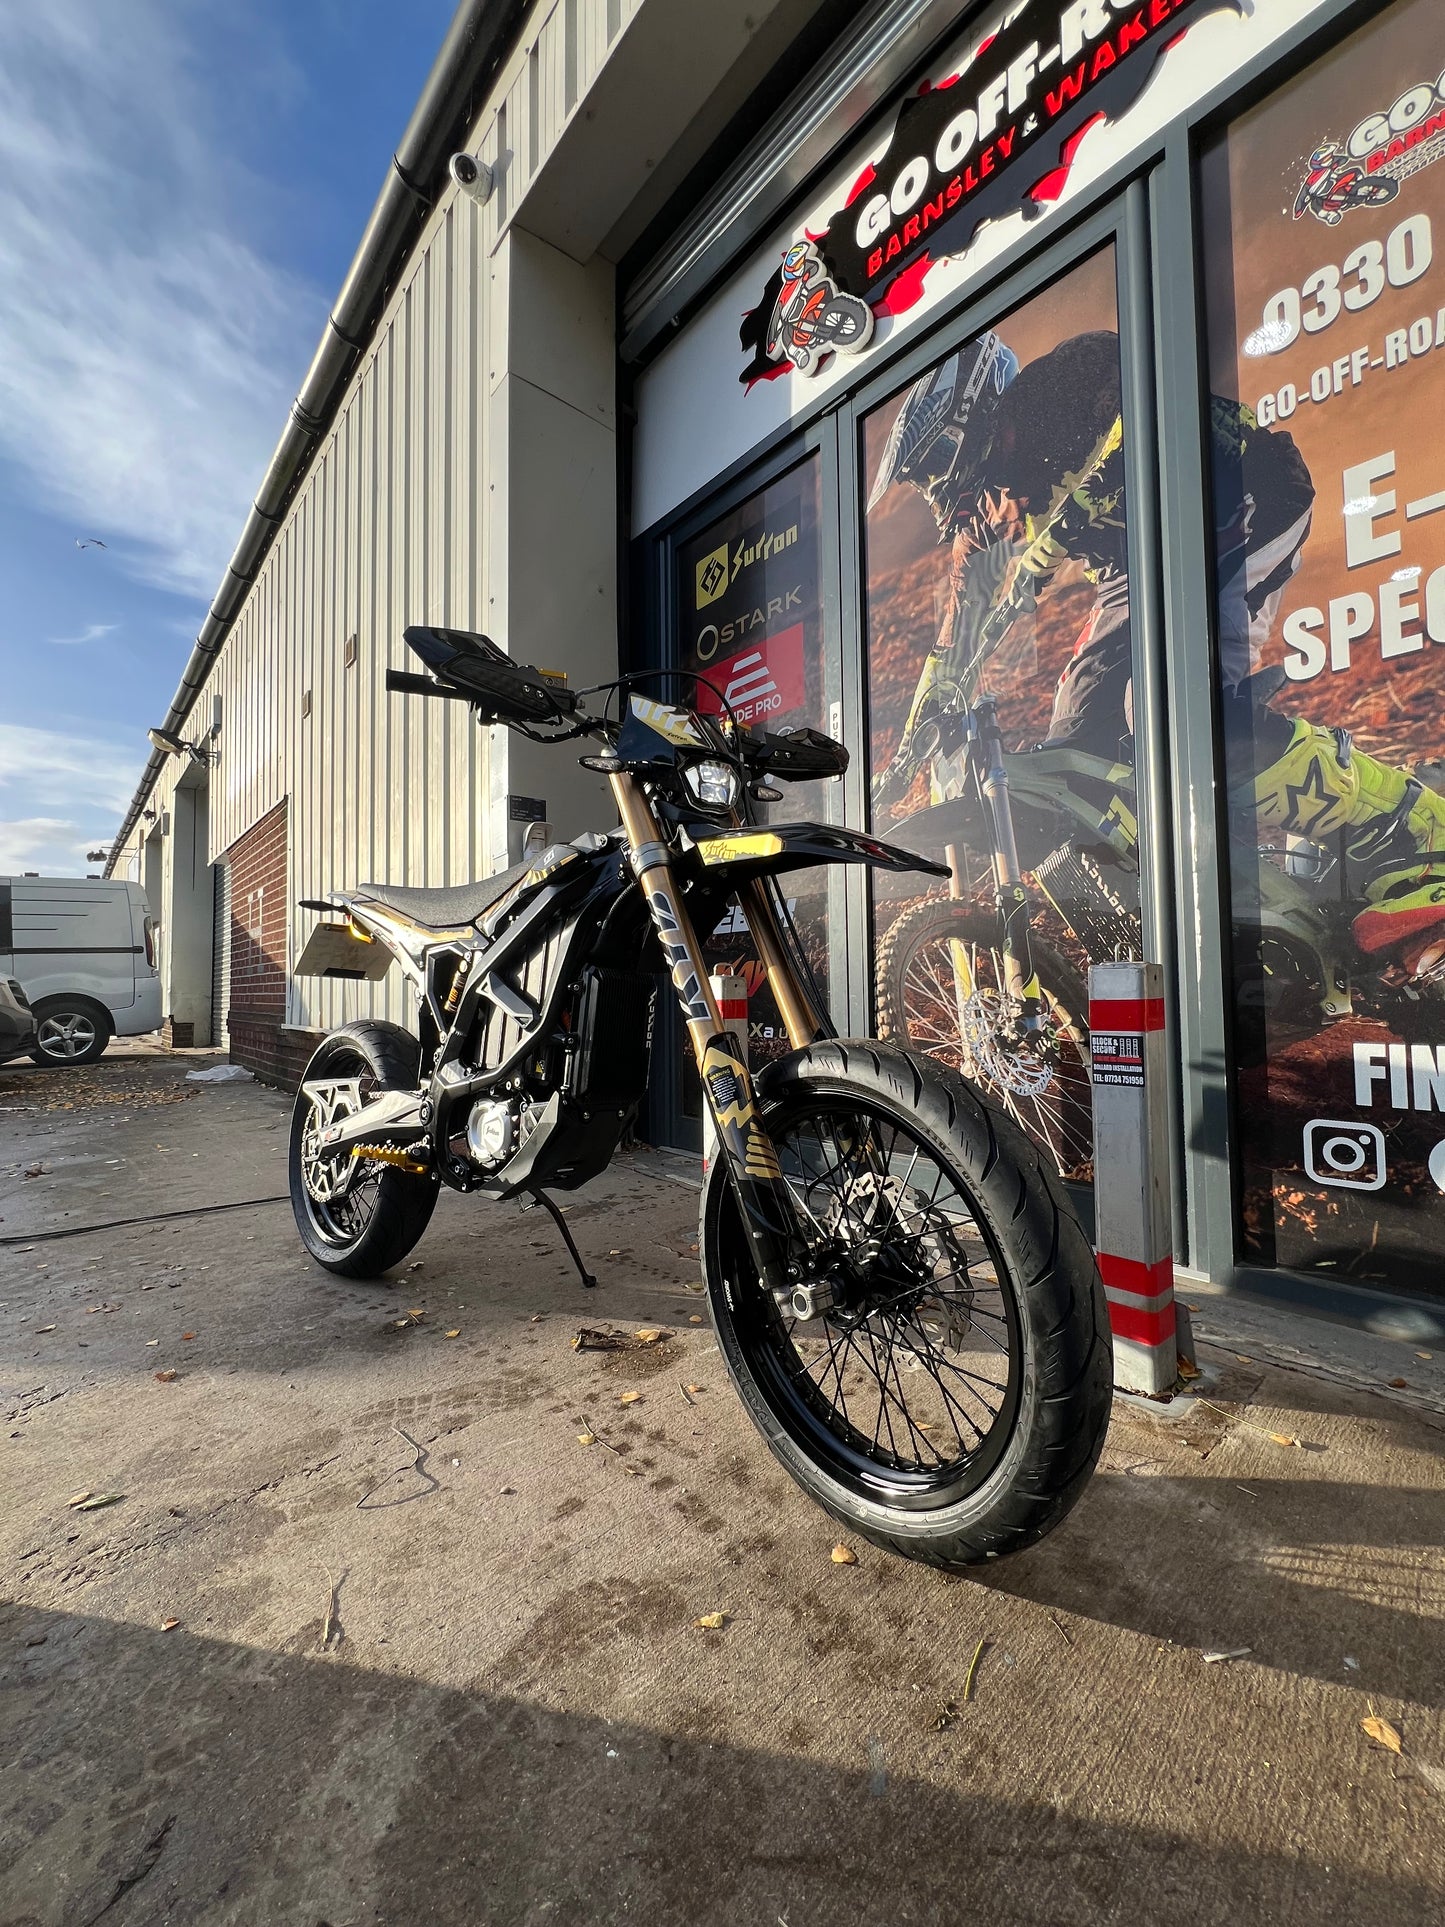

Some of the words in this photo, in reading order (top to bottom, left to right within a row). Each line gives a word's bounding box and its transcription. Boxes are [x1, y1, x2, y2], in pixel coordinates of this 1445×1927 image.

[856, 156, 929, 249] GO
[936, 0, 1137, 173] OFF-R
[867, 126, 1015, 278] BARNSLEY
[1021, 112, 1039, 138] &
[1045, 0, 1186, 117] WAKE
[1263, 213, 1433, 352] 0330
[755, 694, 782, 716] PRO
[1092, 1037, 1112, 1046] BLOCK
[1112, 1038, 1118, 1046] &
[1092, 1046, 1116, 1054] SECURE
[1104, 1074, 1122, 1084] 07734
